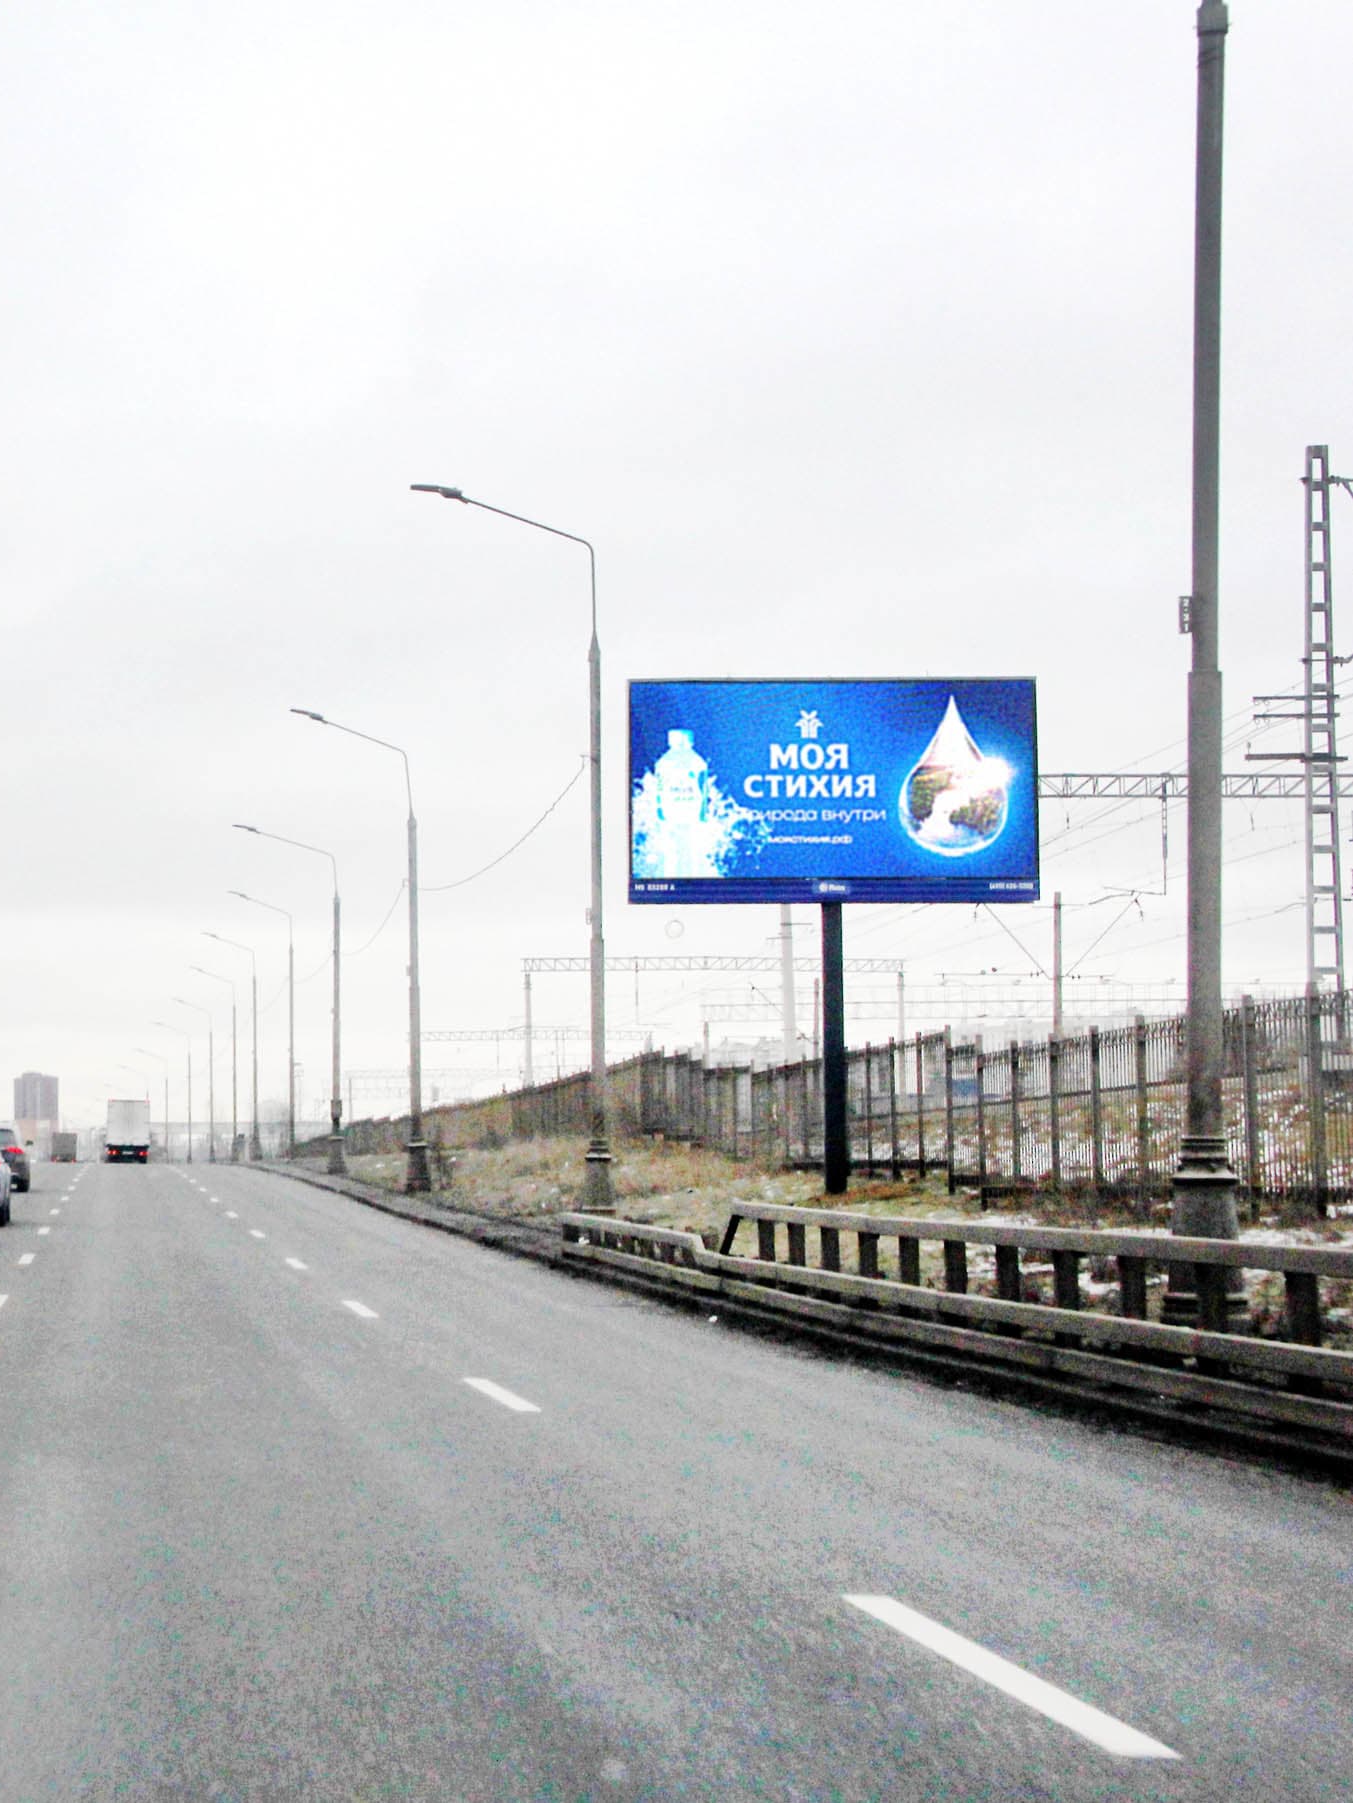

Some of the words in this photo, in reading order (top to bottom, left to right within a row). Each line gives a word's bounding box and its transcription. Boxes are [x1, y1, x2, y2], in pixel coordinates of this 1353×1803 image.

[769, 743, 849, 770] МОЯ
[743, 773, 876, 799] СТИХИЯ
[740, 808, 818, 822] рирода
[821, 809, 887, 823] внутри
